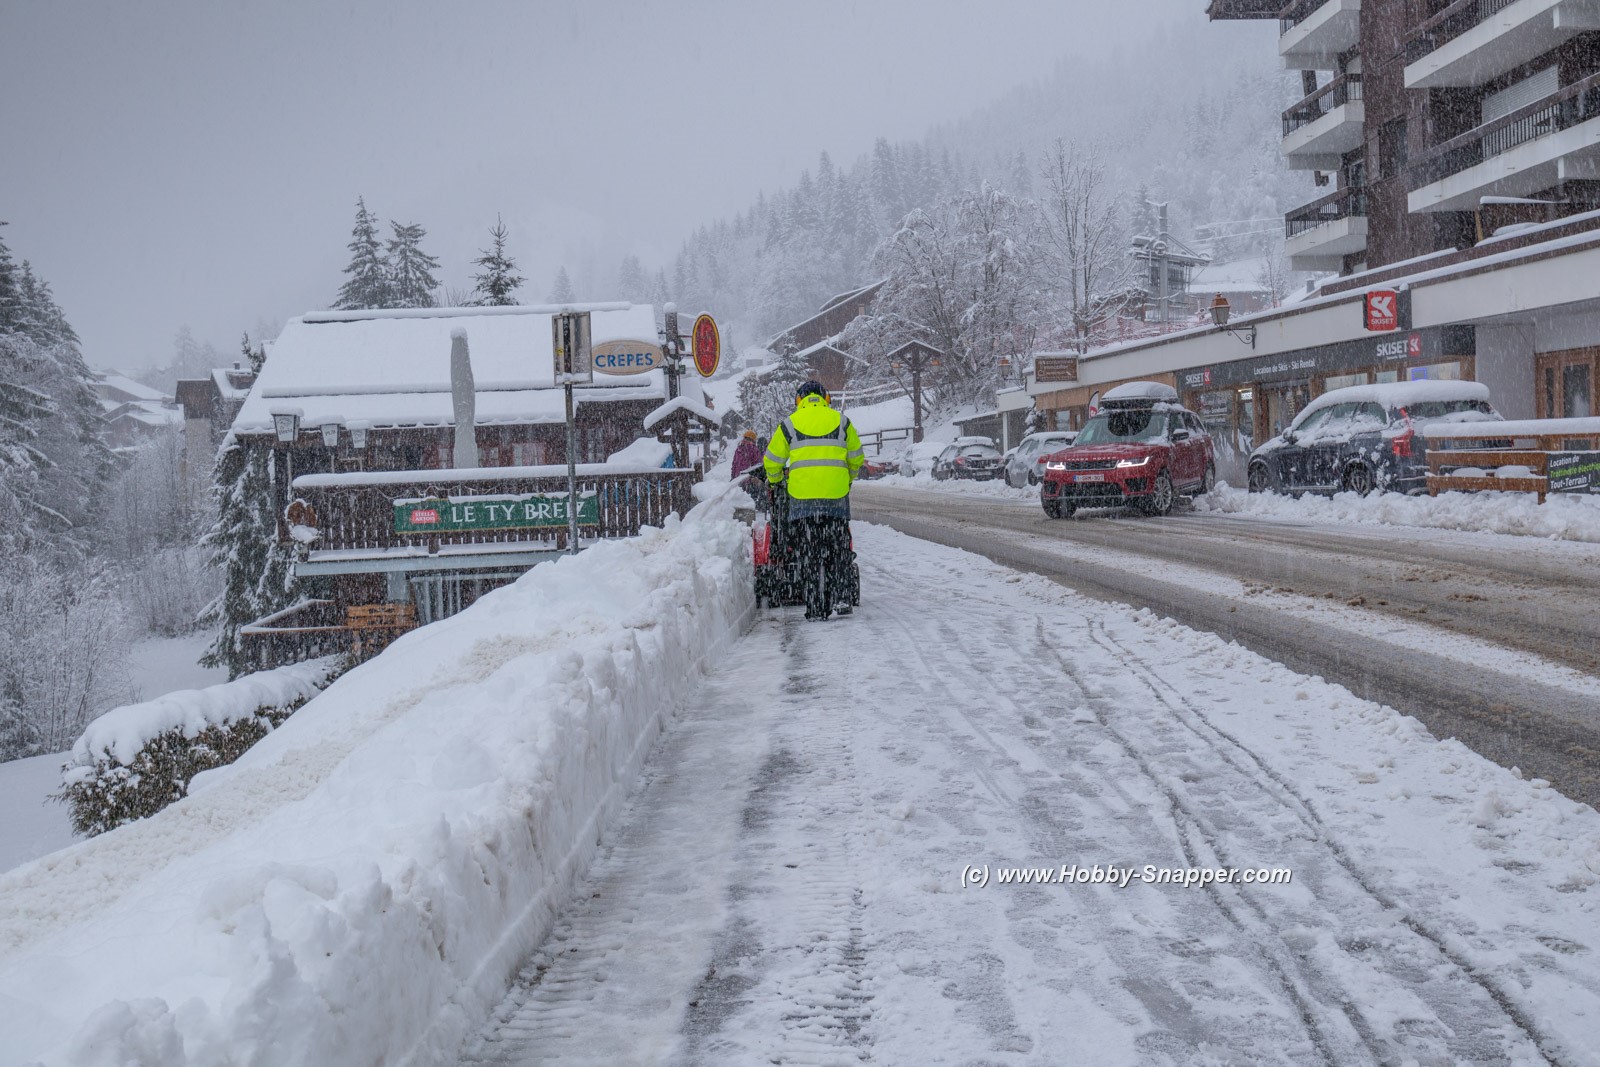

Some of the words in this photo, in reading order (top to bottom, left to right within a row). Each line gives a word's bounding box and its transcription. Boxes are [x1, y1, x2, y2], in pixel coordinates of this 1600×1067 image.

[1376, 340, 1408, 357] SKISET
[1254, 365, 1272, 375] Location
[1272, 365, 1278, 373] de
[1278, 363, 1288, 372] Skis
[1291, 360, 1299, 370] Ski
[1300, 358, 1316, 369] Rental
[1185, 373, 1204, 384] SKISET
[1550, 457, 1572, 467] Location
[1572, 455, 1580, 463] de
[1550, 475, 1587, 489] Tout-Terrain
[452, 506, 476, 523] LE
[485, 504, 515, 521] TY
[525, 501, 586, 520] BREIZ
